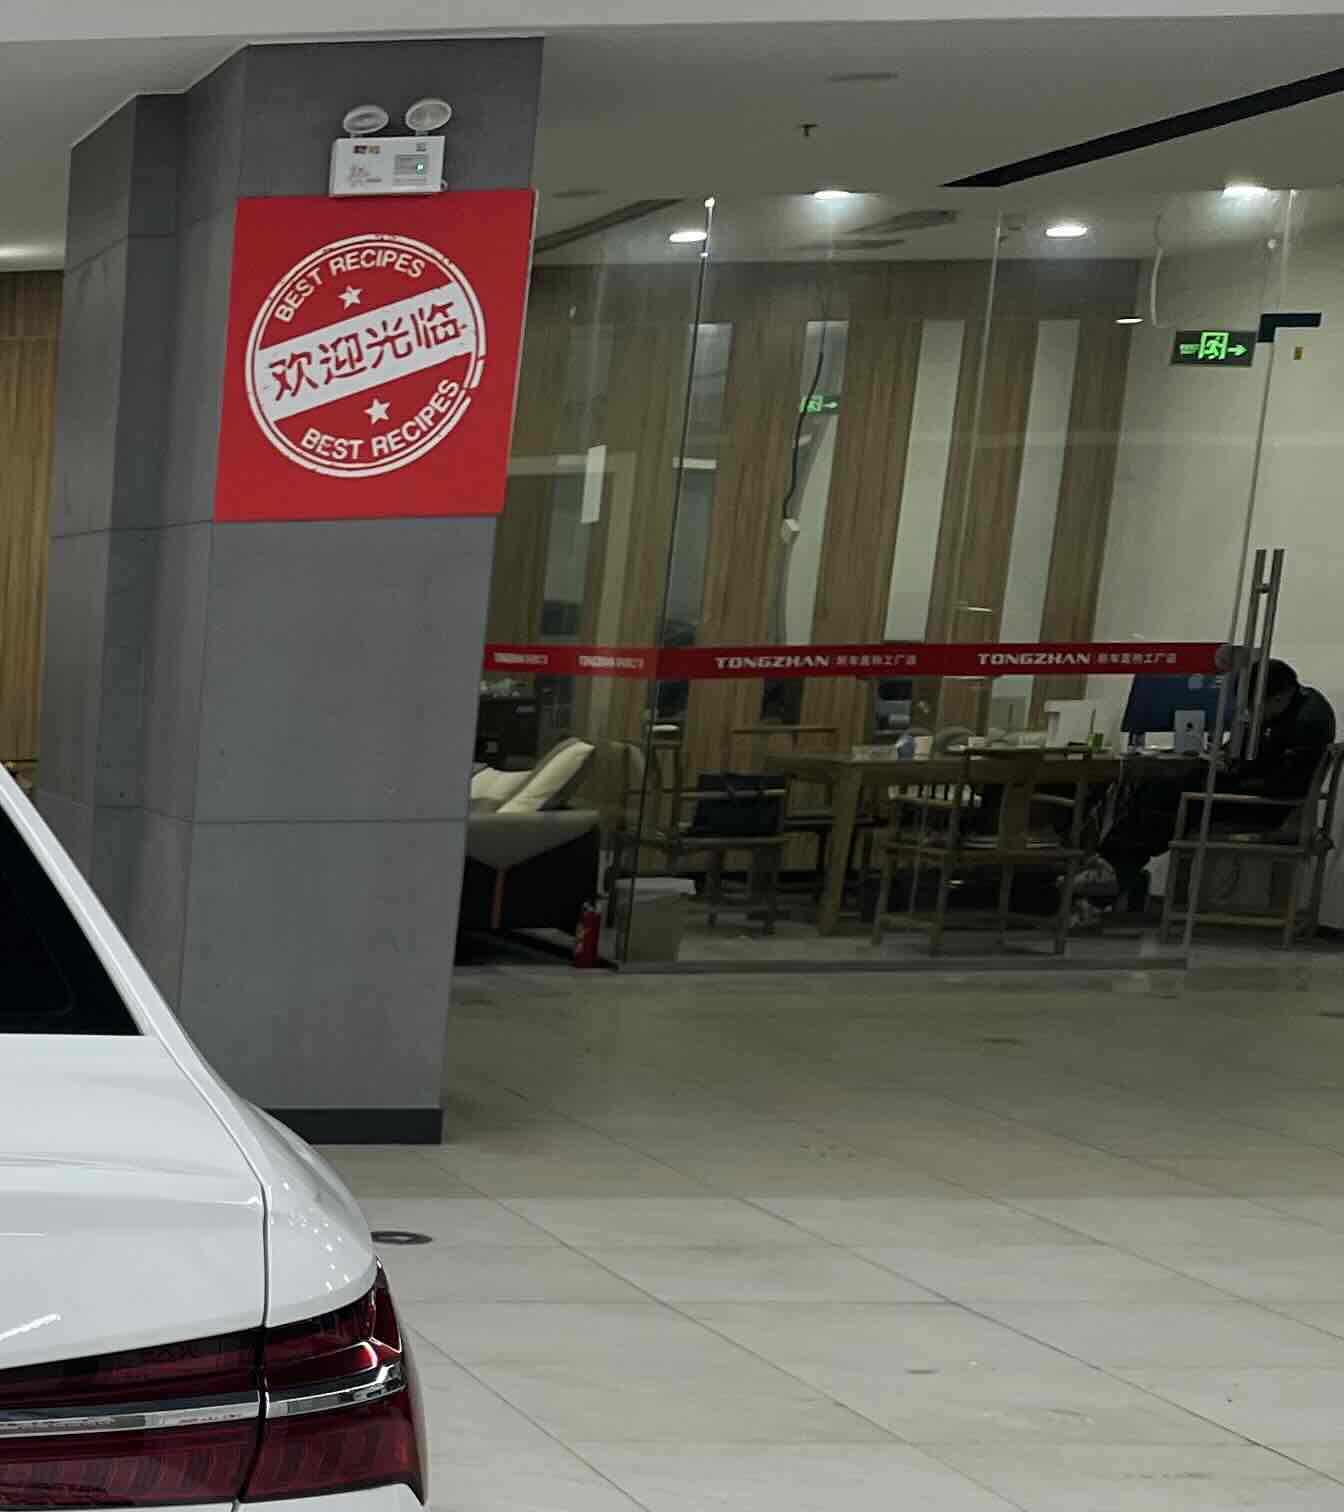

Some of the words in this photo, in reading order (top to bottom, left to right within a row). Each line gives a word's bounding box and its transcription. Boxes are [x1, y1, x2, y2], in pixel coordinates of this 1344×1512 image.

[275, 267, 323, 323] BEST
[329, 248, 425, 279] RECIPES
[269, 301, 467, 402] 欢迎光临
[300, 427, 364, 460] BEST
[371, 378, 460, 458] RECIPES
[715, 655, 830, 669] TONGZHAN
[977, 652, 1091, 665] TONGZHAN
